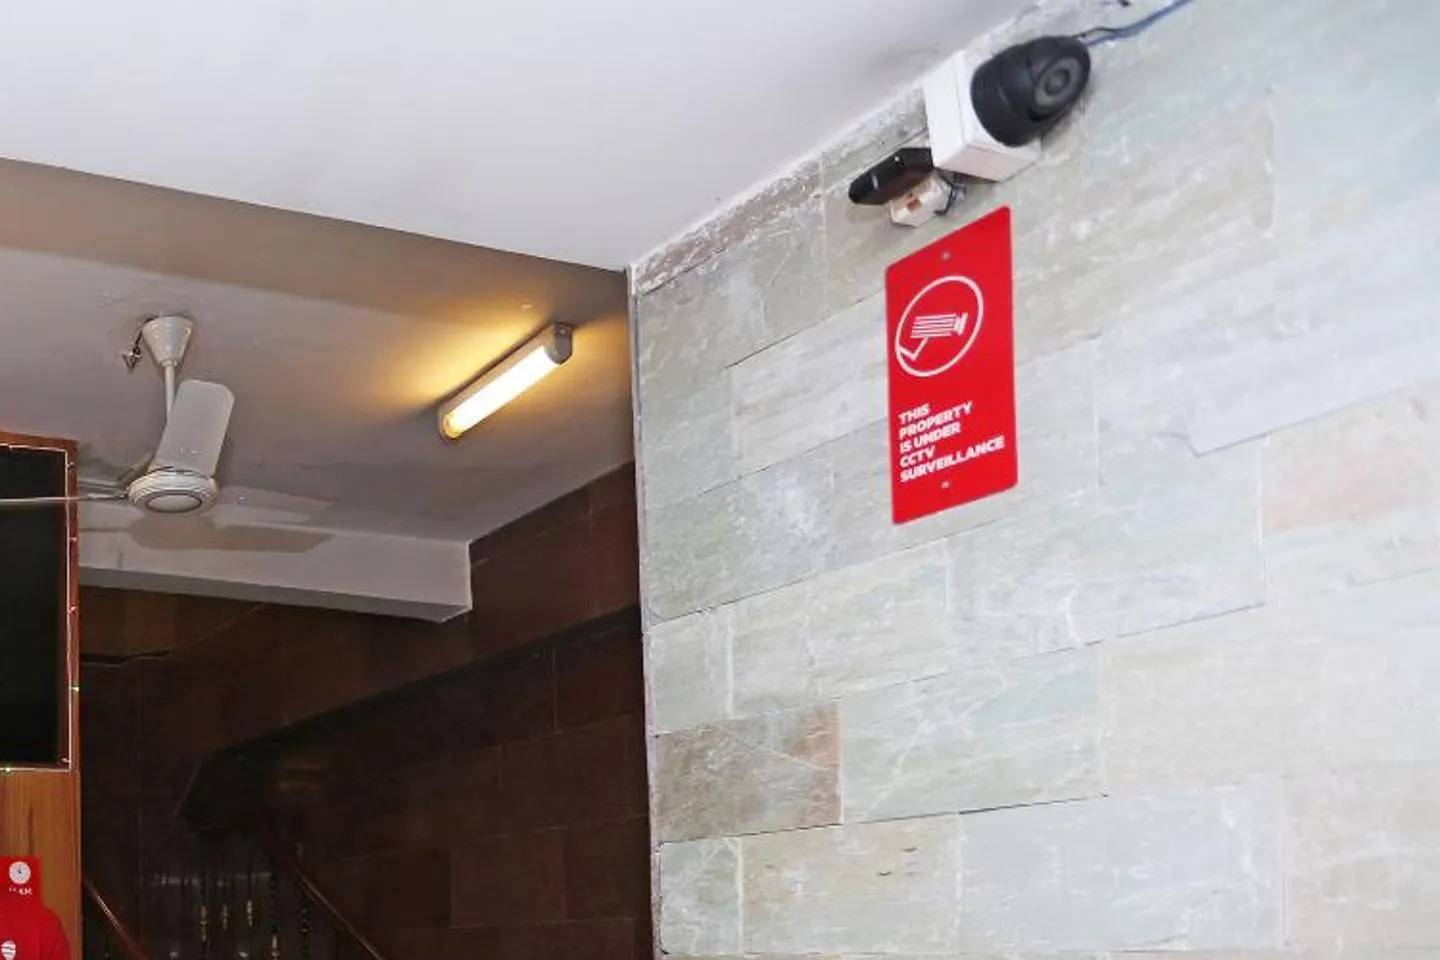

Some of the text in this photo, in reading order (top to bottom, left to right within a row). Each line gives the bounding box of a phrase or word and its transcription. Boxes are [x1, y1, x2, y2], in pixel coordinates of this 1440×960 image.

[898, 403, 930, 424] THIS
[898, 401, 973, 439] PROPERTY
[900, 422, 961, 454] IS UNDER
[900, 446, 936, 468] CCTV
[900, 436, 1005, 482] SURVEILLANCE
